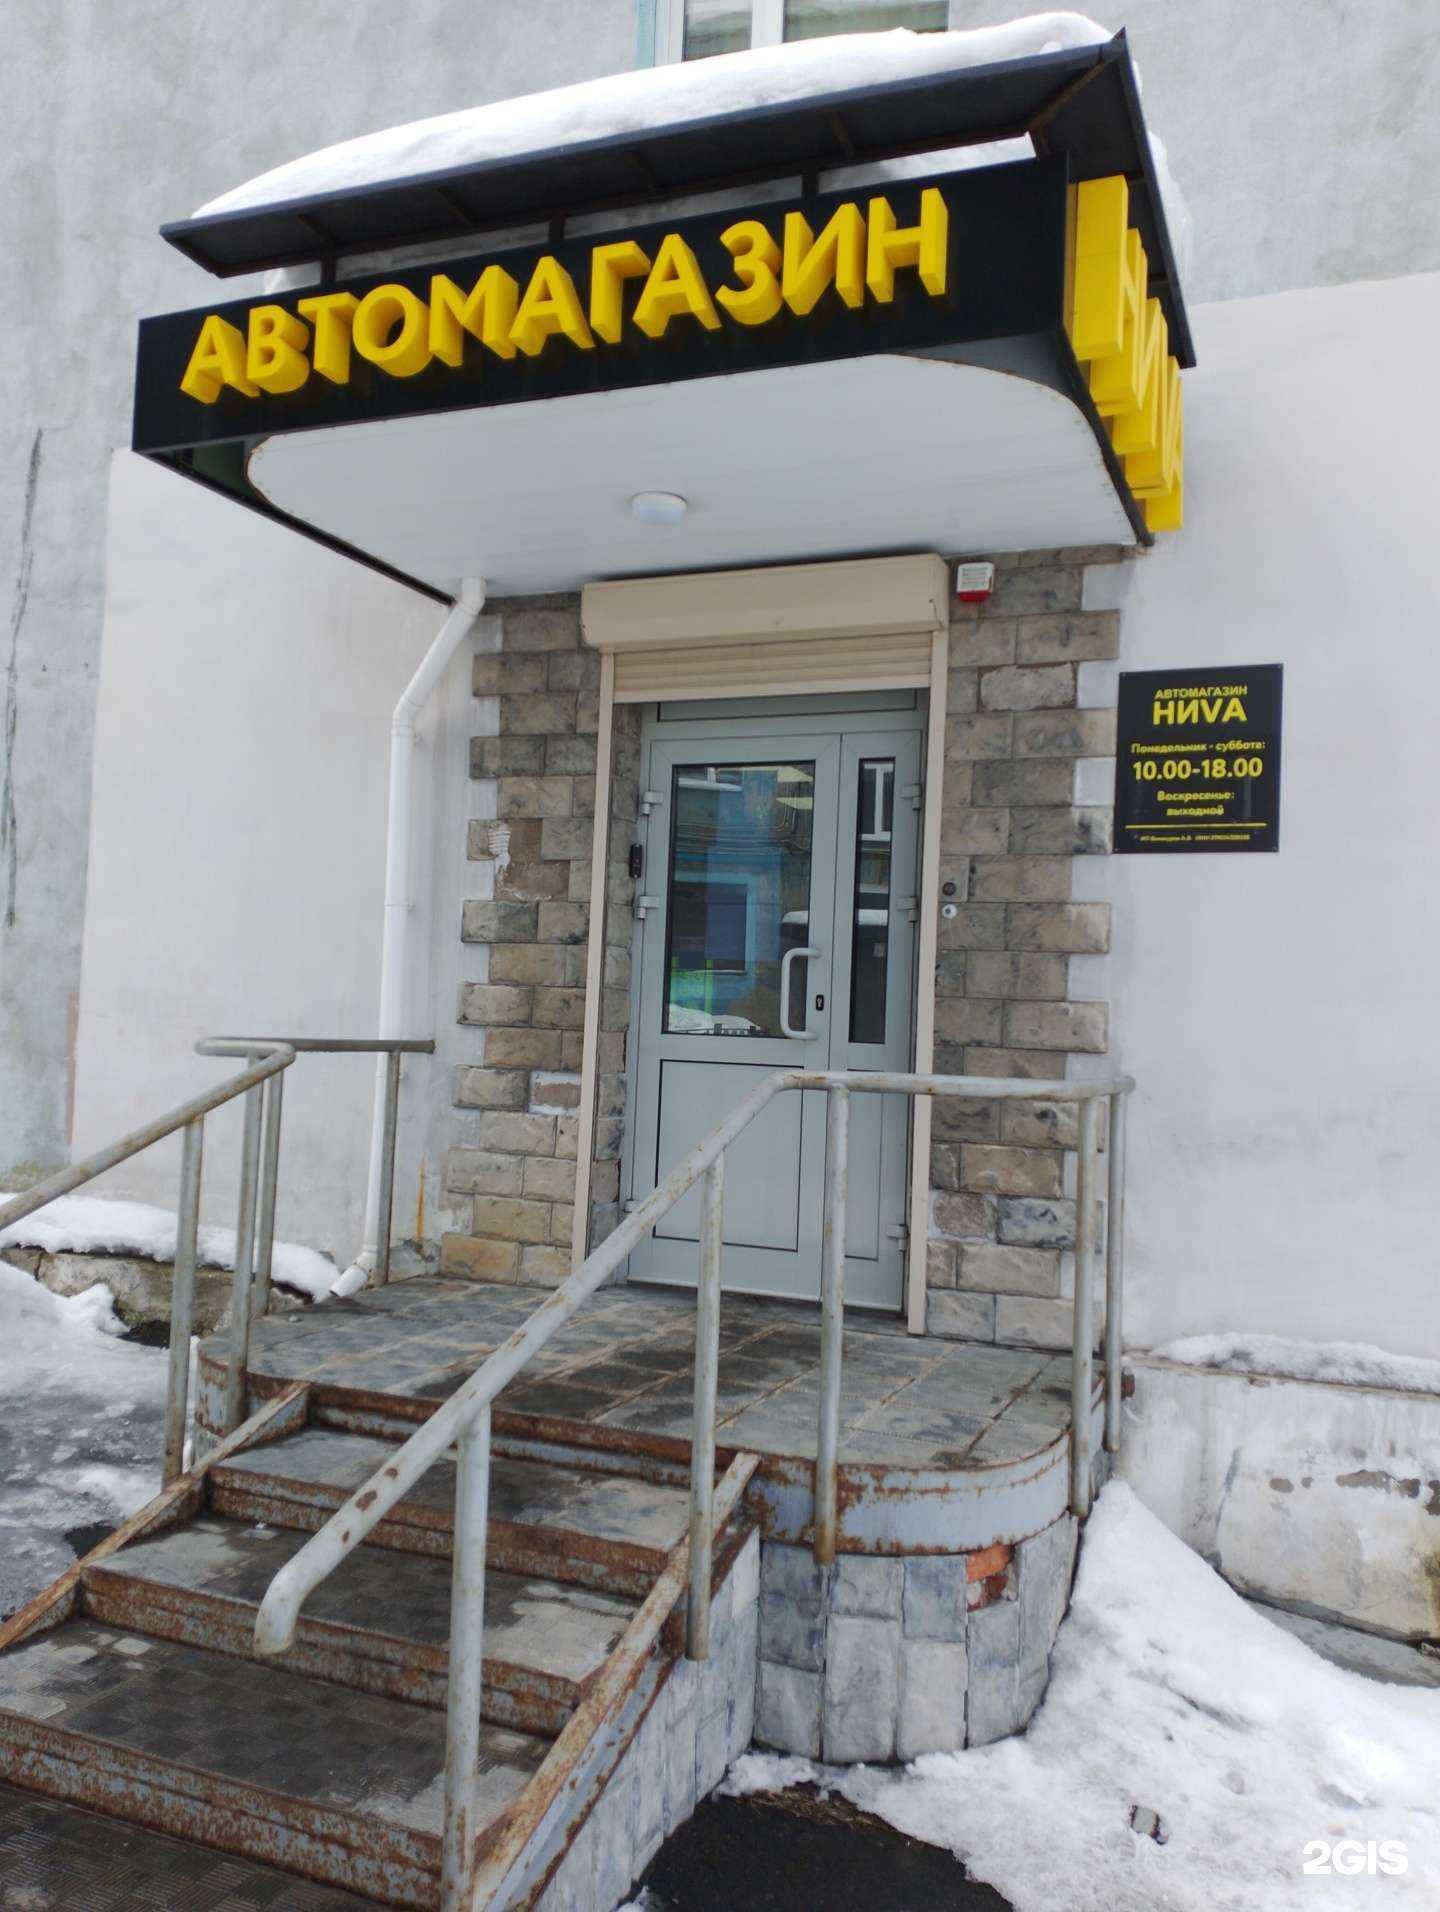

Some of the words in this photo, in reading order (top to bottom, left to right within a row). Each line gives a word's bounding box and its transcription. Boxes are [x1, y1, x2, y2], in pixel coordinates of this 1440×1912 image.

[180, 188, 949, 405] АВТОМАГАЗИН
[1153, 685, 1248, 700] АВТОМАГАЗИН
[1131, 742, 1207, 754] Понедельник
[1215, 740, 1266, 754] суббота:
[1132, 757, 1263, 781] 10.00-18.00
[1157, 790, 1235, 803] Воскресенье:
[1166, 805, 1225, 817] выходной
